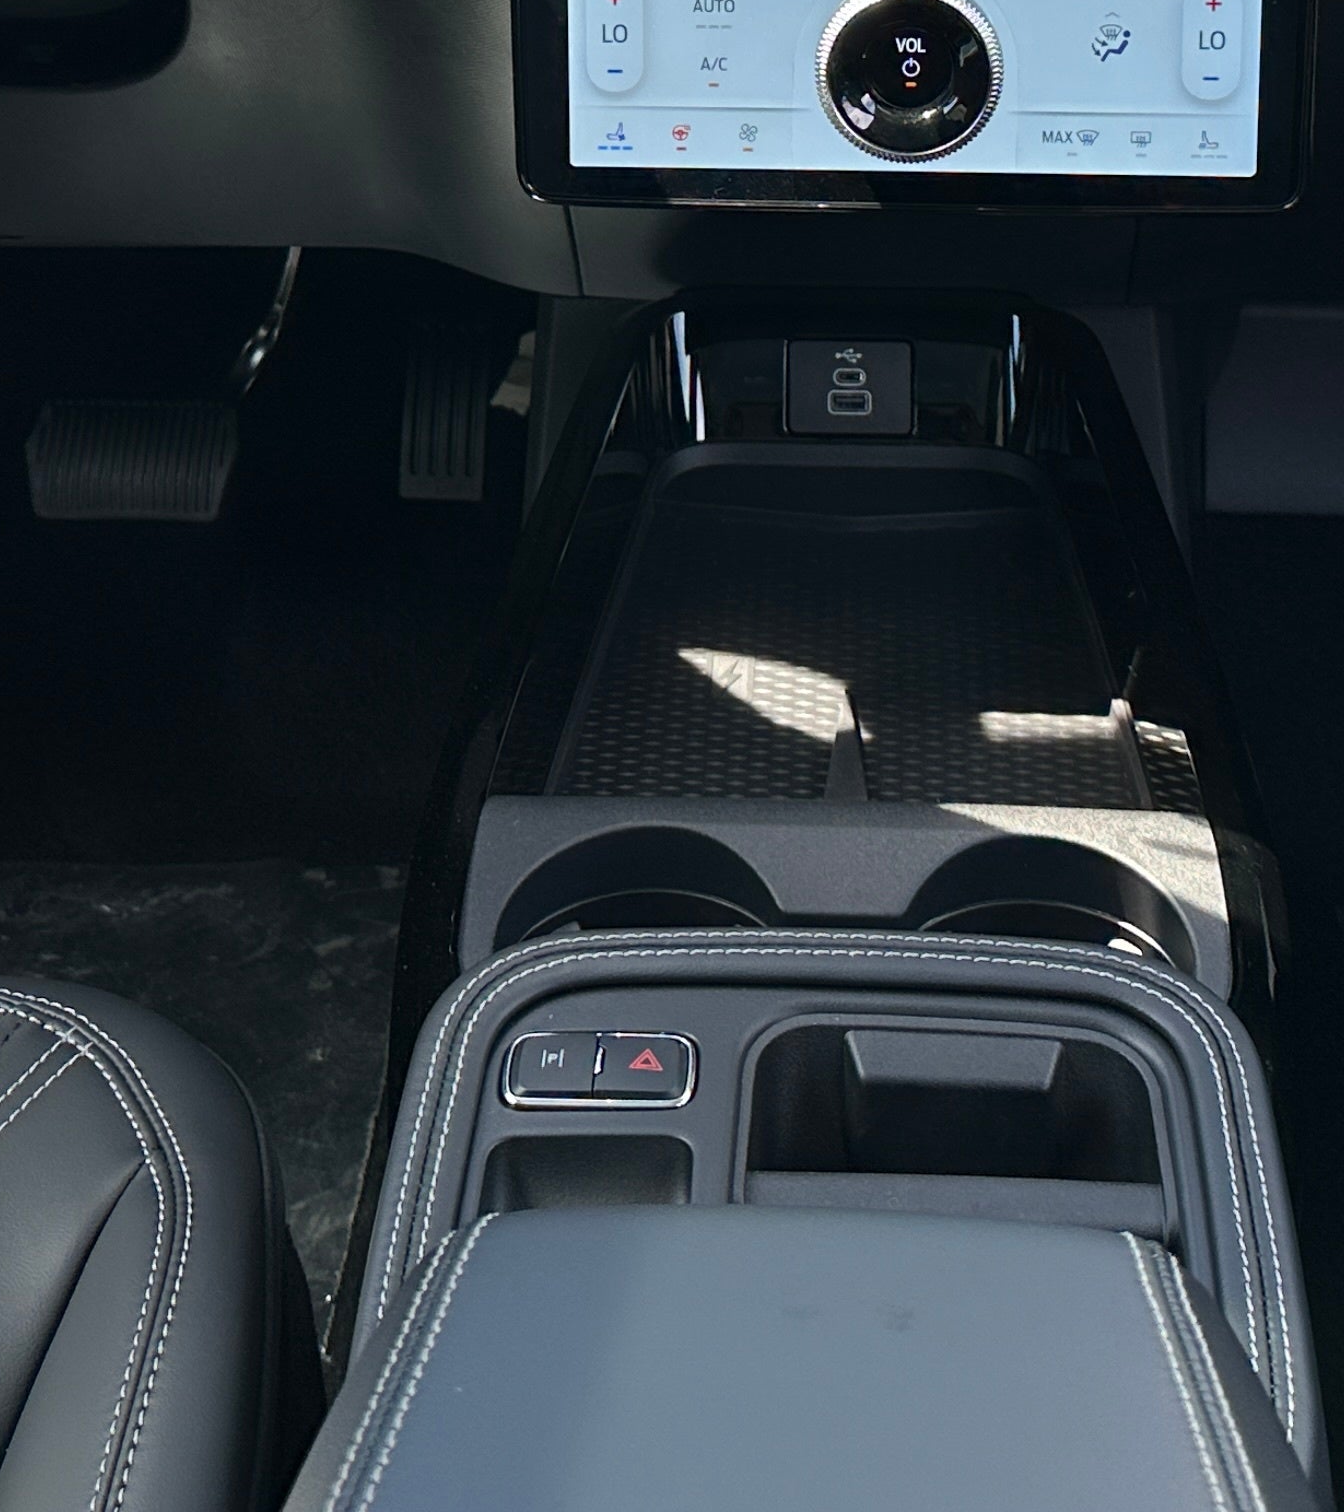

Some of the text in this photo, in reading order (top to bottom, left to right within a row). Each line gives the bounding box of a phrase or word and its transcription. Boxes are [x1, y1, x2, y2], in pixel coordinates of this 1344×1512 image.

[602, 23, 628, 44] LO
[1199, 30, 1226, 50] LO
[895, 37, 926, 54] VOL
[700, 57, 728, 72] A/C
[1042, 130, 1074, 144] MAX
